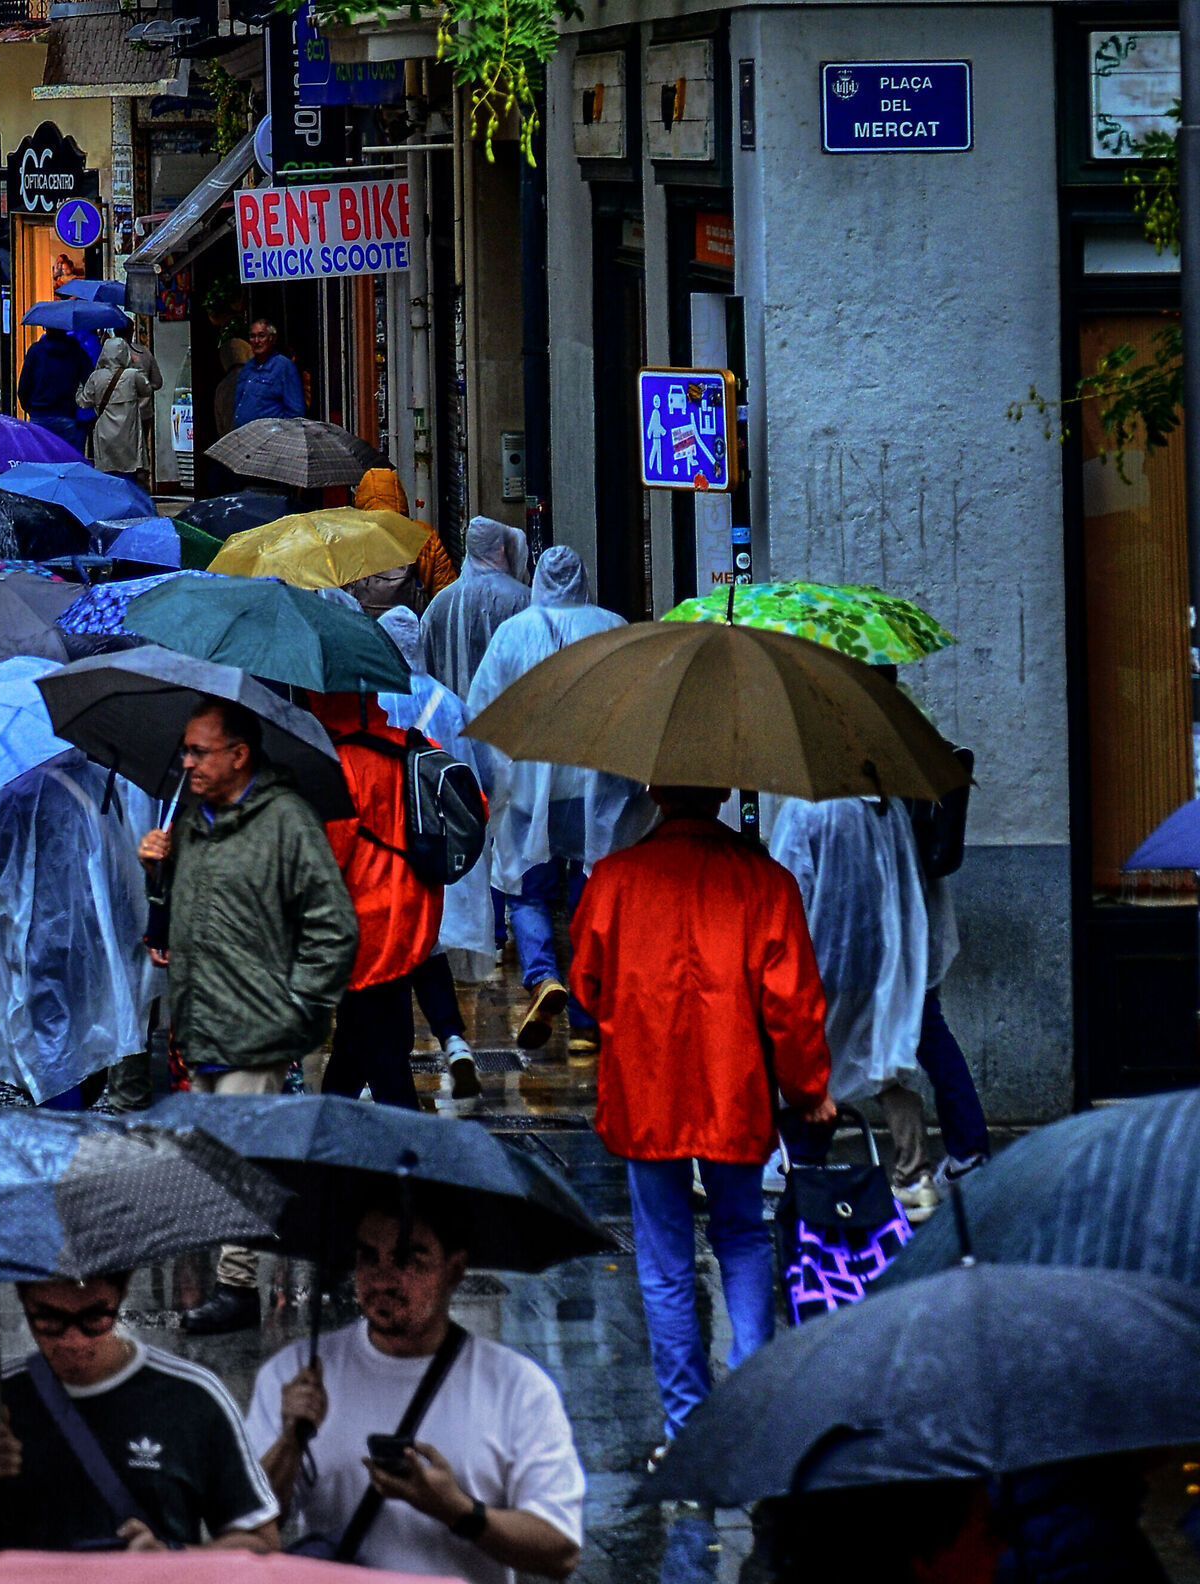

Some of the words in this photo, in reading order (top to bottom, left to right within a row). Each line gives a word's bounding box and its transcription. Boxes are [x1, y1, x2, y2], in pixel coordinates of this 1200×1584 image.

[880, 76, 933, 92] PLAÇA
[881, 99, 912, 112] DEL
[854, 121, 940, 138] MERCAT
[49, 174, 75, 190] CENTRO
[238, 189, 331, 249] RENT
[243, 248, 315, 279] E-KICK
[320, 241, 411, 275] SCOOTE
